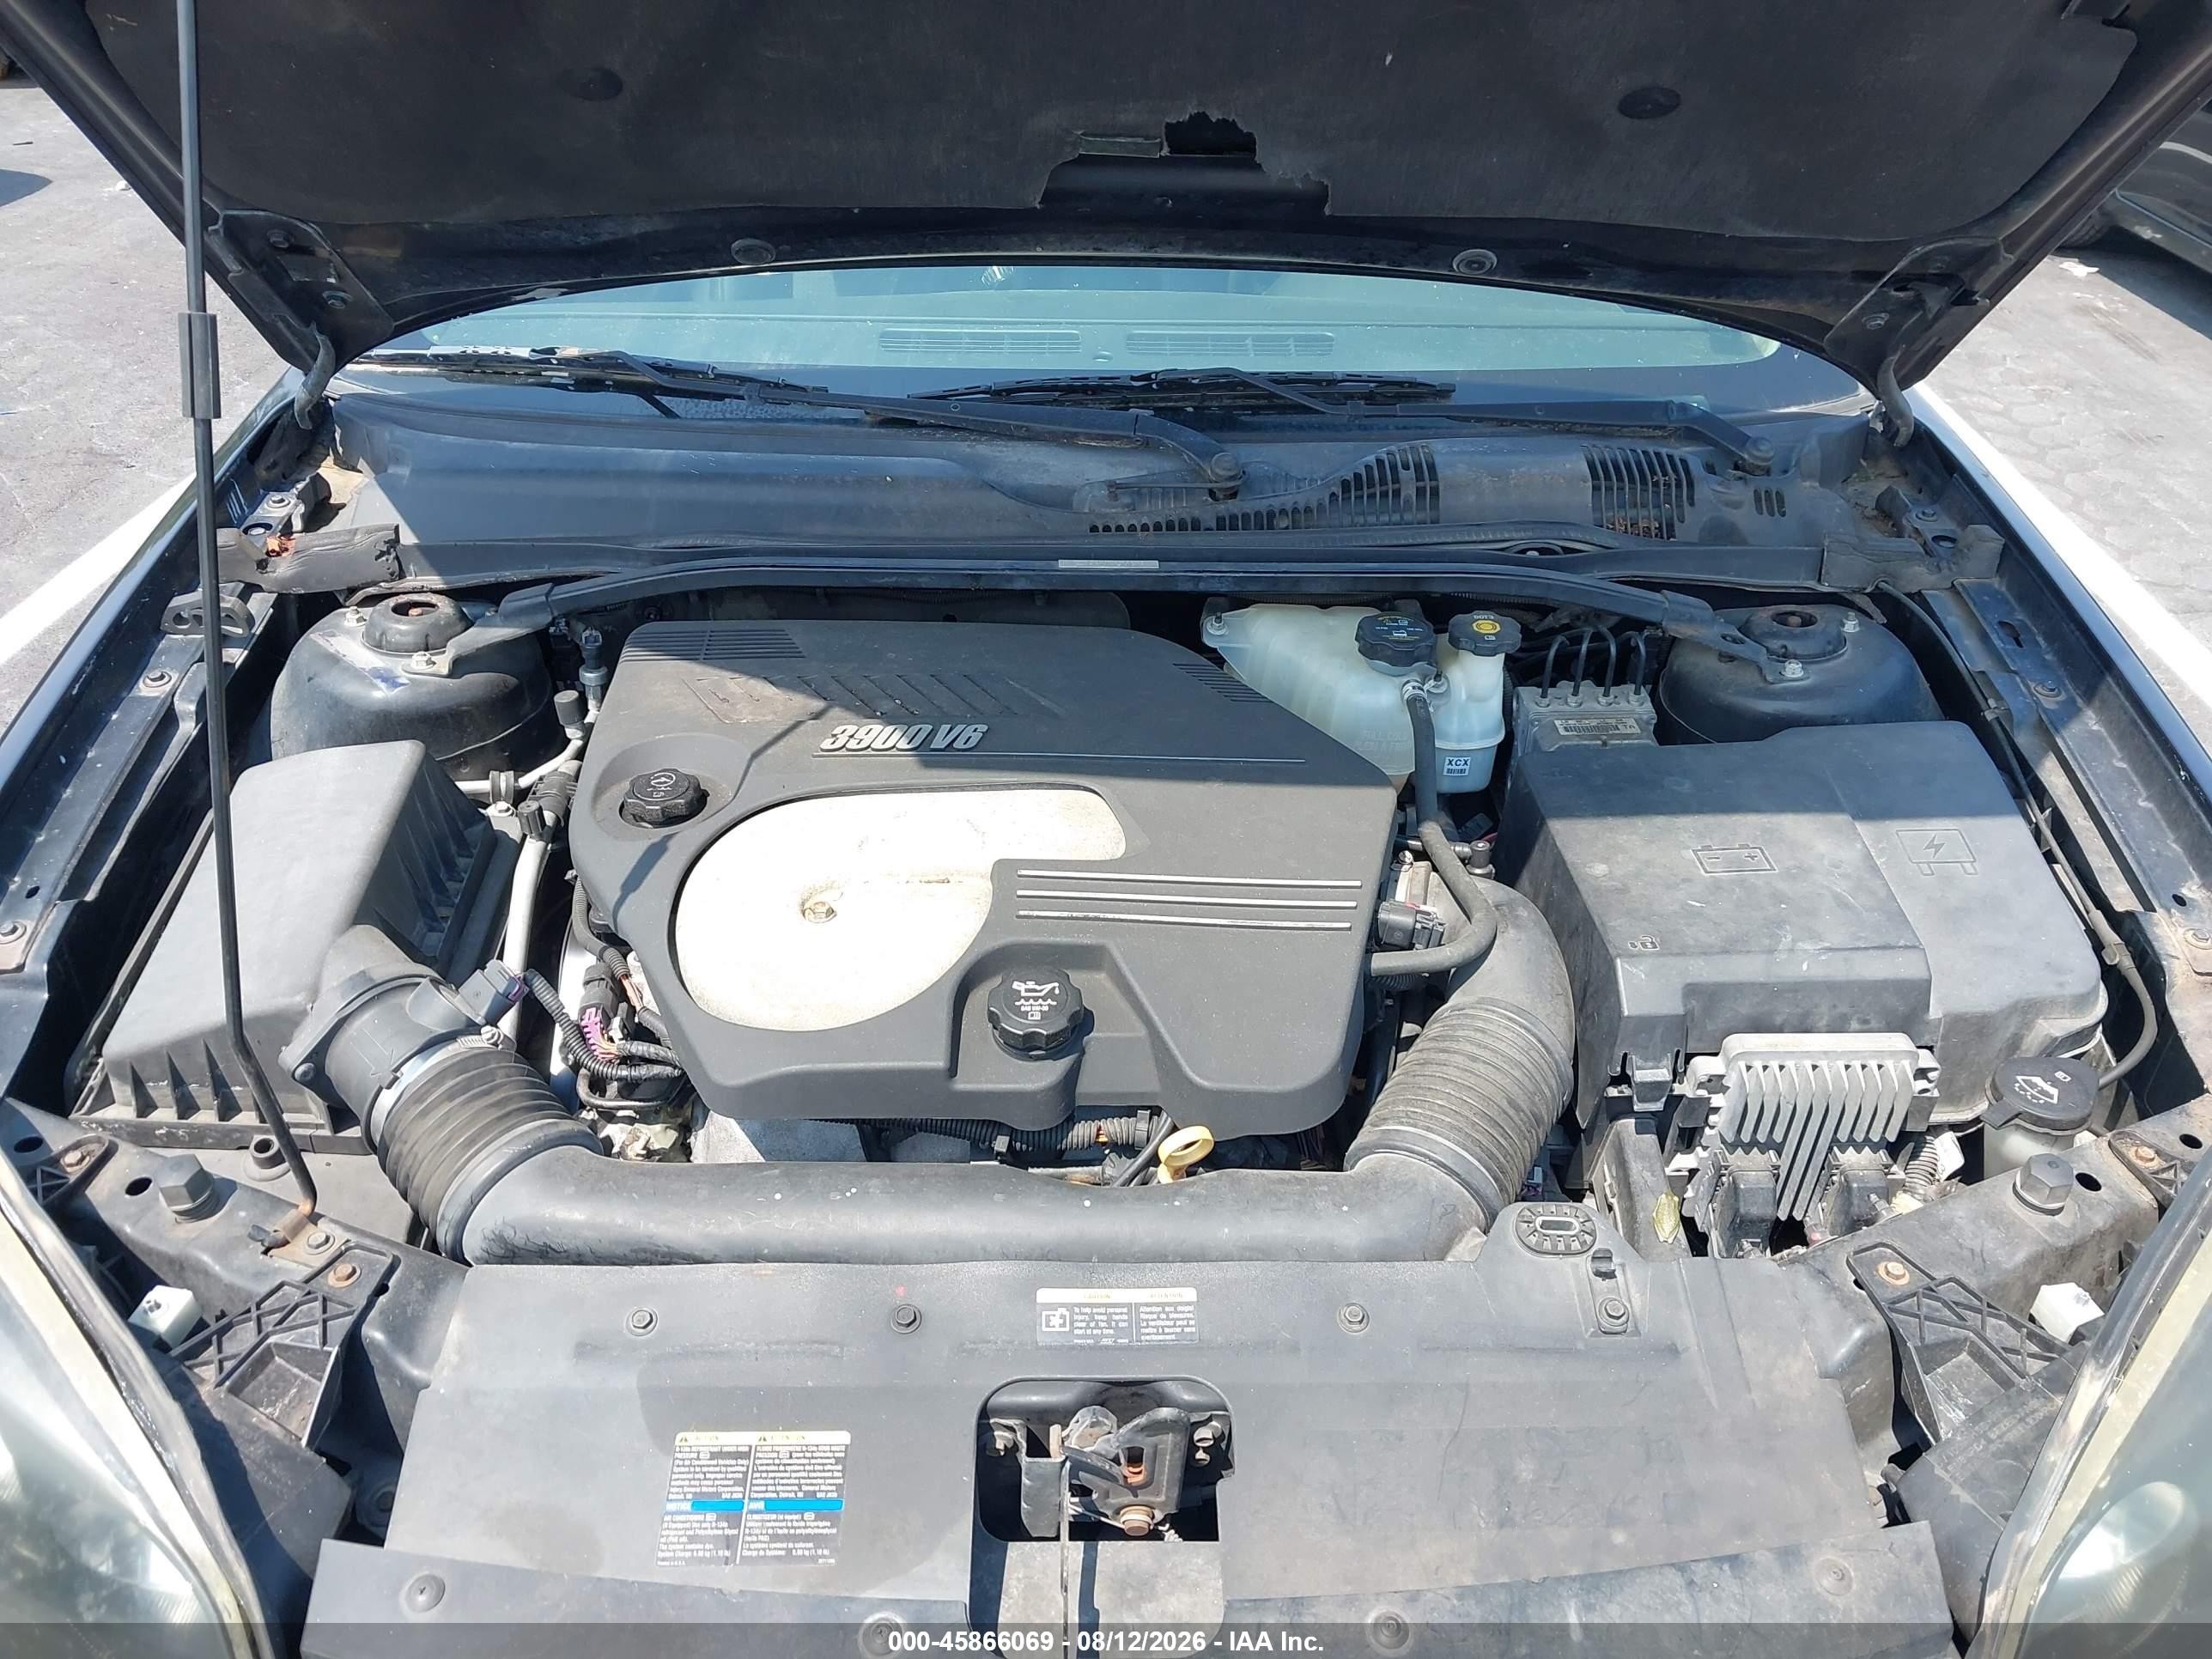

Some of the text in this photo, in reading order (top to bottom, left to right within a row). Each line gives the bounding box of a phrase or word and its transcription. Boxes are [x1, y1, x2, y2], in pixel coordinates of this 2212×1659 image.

[819, 724, 989, 751] 3900 V6
[1447, 758, 1469, 767] XCX
